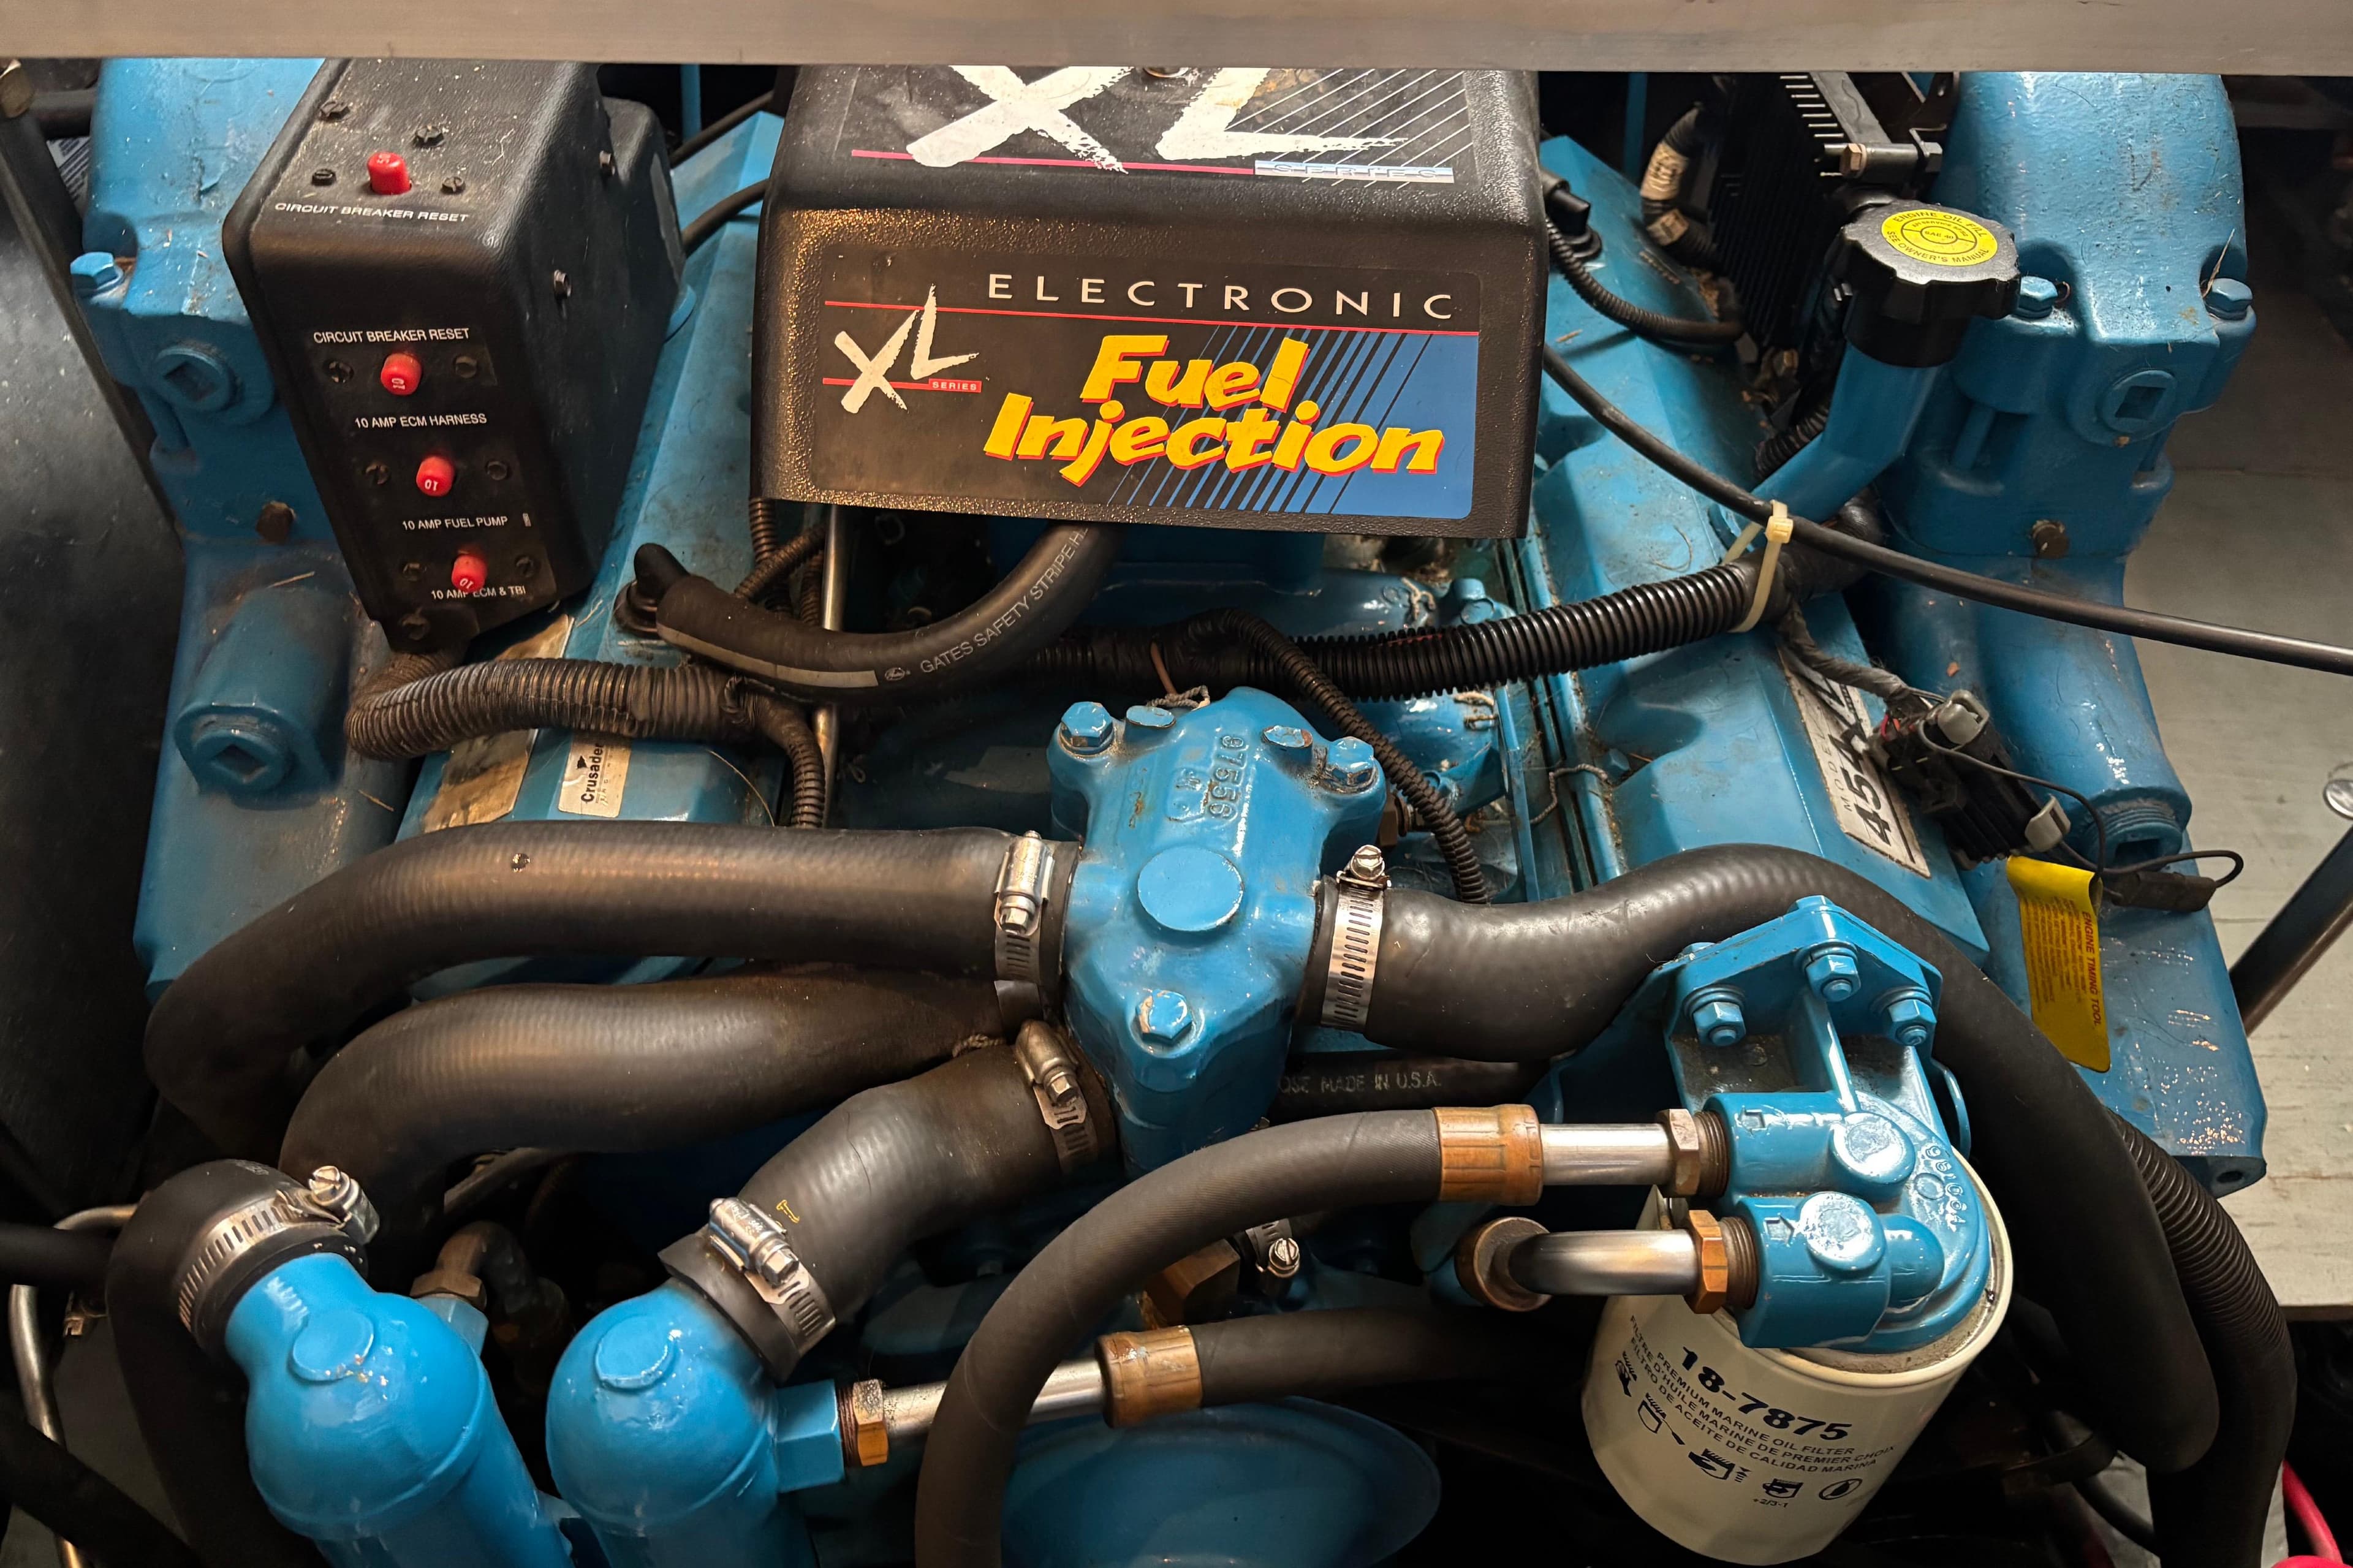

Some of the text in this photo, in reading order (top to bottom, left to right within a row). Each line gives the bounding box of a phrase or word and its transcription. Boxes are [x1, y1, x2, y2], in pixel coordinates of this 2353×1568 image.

[275, 203, 469, 222] CIRCUIT BREAKER RESET
[1893, 211, 1937, 223] ENGINE
[1944, 215, 1963, 224] OIL
[1966, 222, 1987, 238] FILL
[1887, 231, 1989, 263] SEE OWNER'S MANUAL
[988, 273, 1452, 320] ELECTRONIC
[313, 327, 469, 344] CIRCUIT BREAKER RESET
[834, 282, 979, 414] XL
[932, 381, 977, 391] SERIES
[1080, 334, 1310, 412] Fuel
[354, 413, 487, 428] 10 AMP ECM HARNESS
[983, 392, 1446, 487] Injection
[402, 515, 508, 531] 10 AMP FUEL PUMP
[431, 589, 444, 600] 10
[499, 586, 507, 596] &
[508, 585, 526, 595] TBI
[920, 641, 974, 673] GATES
[973, 596, 1031, 647] SAFETY
[1029, 543, 1076, 602] STRIPE
[580, 743, 604, 805] Crusader
[1828, 734, 1892, 847] 454
[2082, 911, 2101, 1027] ENGINE TIMING TOOL
[1374, 1073, 1389, 1091] IN
[1396, 1071, 1442, 1089] U.S.A.
[1630, 1315, 1895, 1464] FILTRE D'HUILE MARINE DE PREMIER CHOIX
[1631, 1336, 1877, 1473] FILTRO DE ACEITE DE CALIDAD MARINA
[1657, 1352, 1855, 1455] PREMIUM MARINE OIL FILTER
[1683, 1346, 1852, 1441] 18-7875
